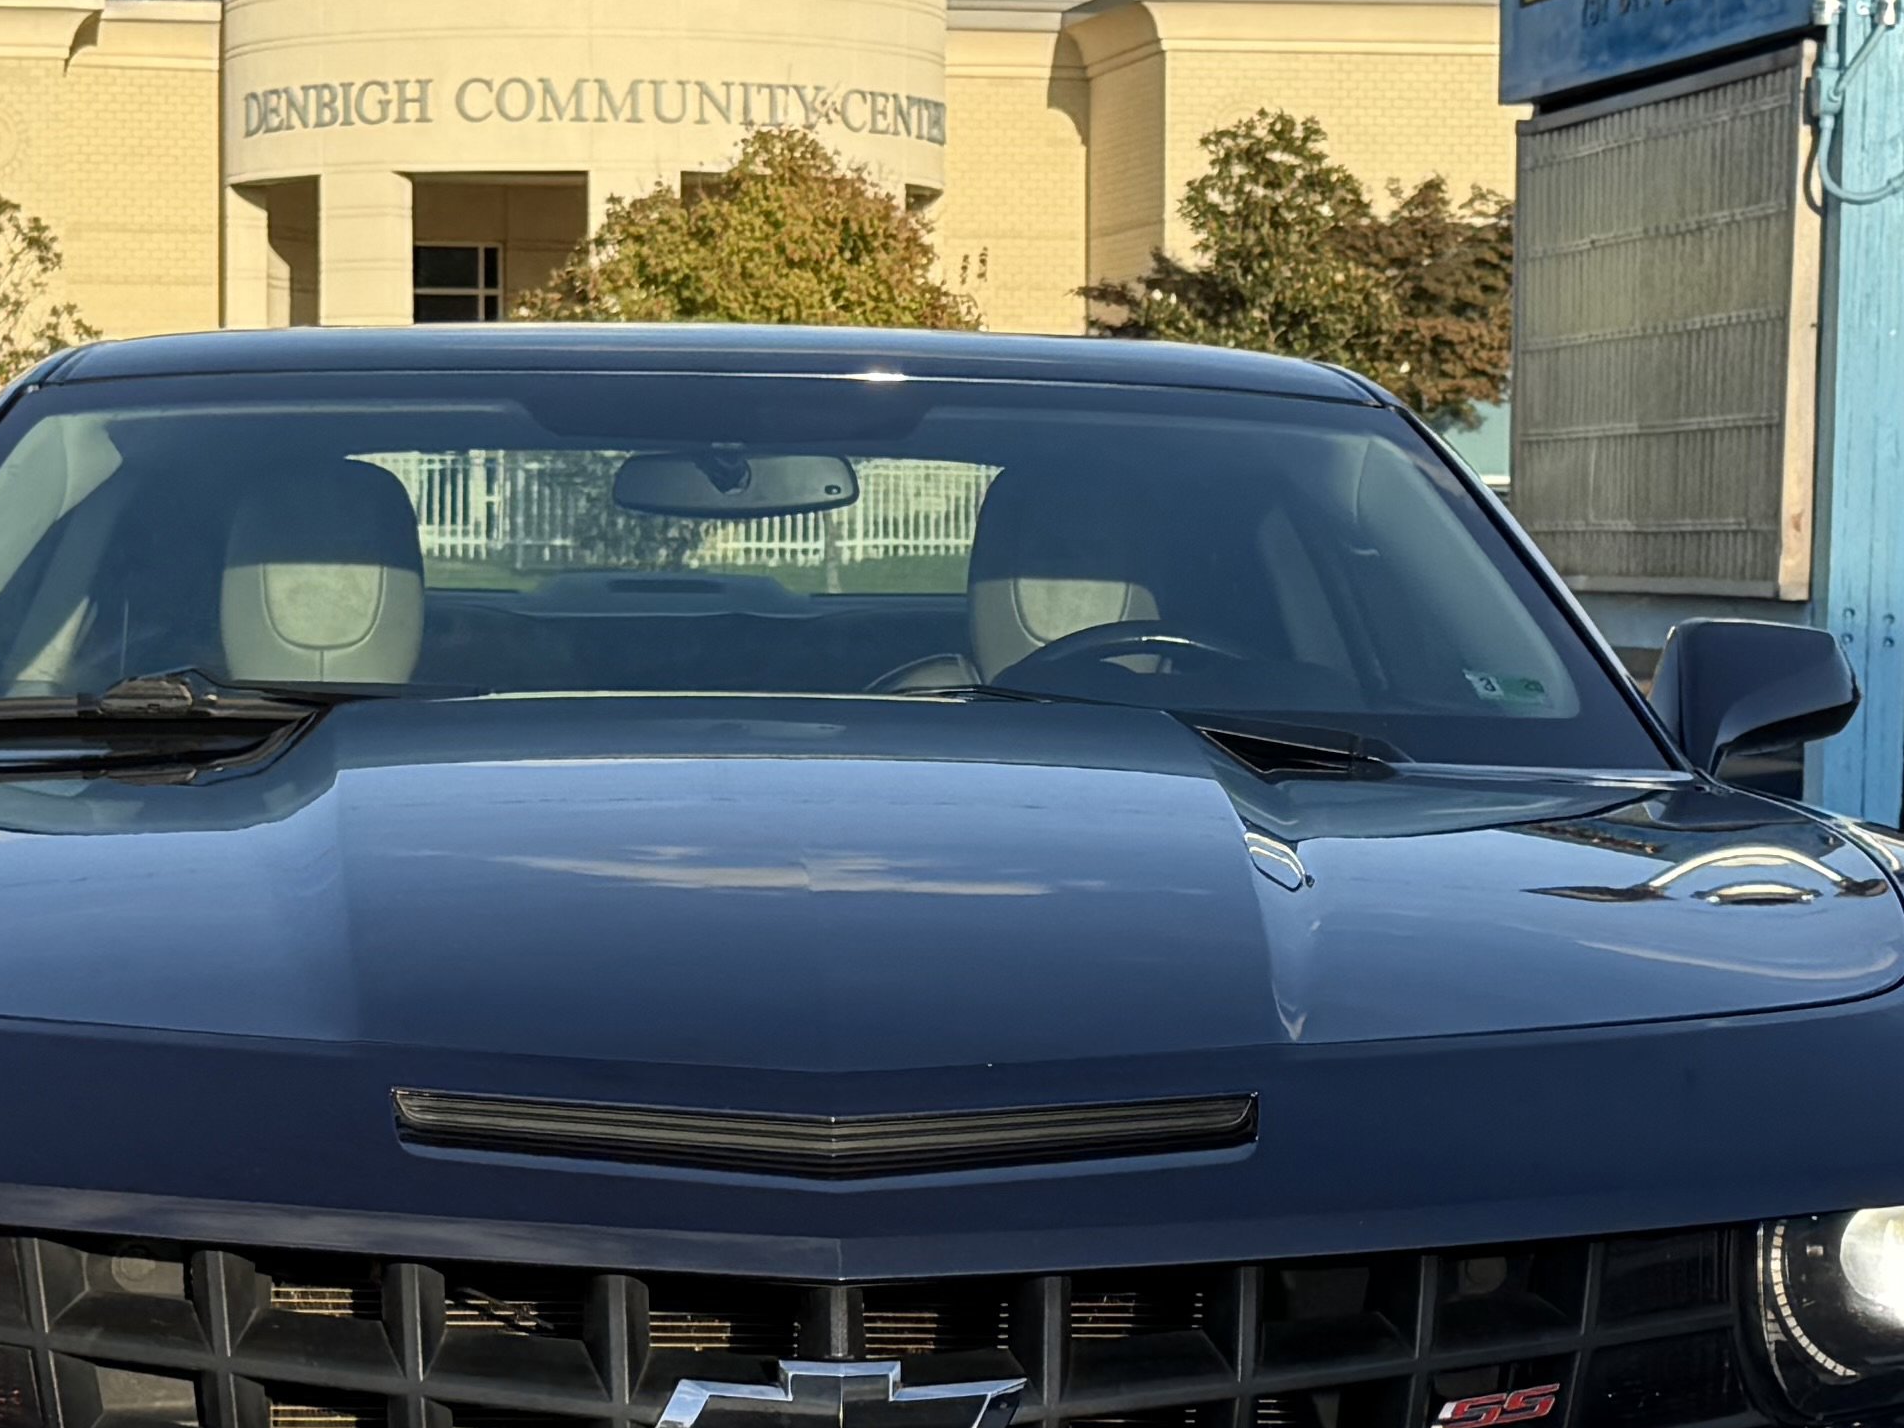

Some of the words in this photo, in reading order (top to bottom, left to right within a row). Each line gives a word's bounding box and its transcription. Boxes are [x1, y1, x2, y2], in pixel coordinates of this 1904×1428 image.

[243, 78, 434, 139] DENBIGH
[456, 77, 827, 132] COMMUNITY
[840, 88, 947, 147] CENTE
